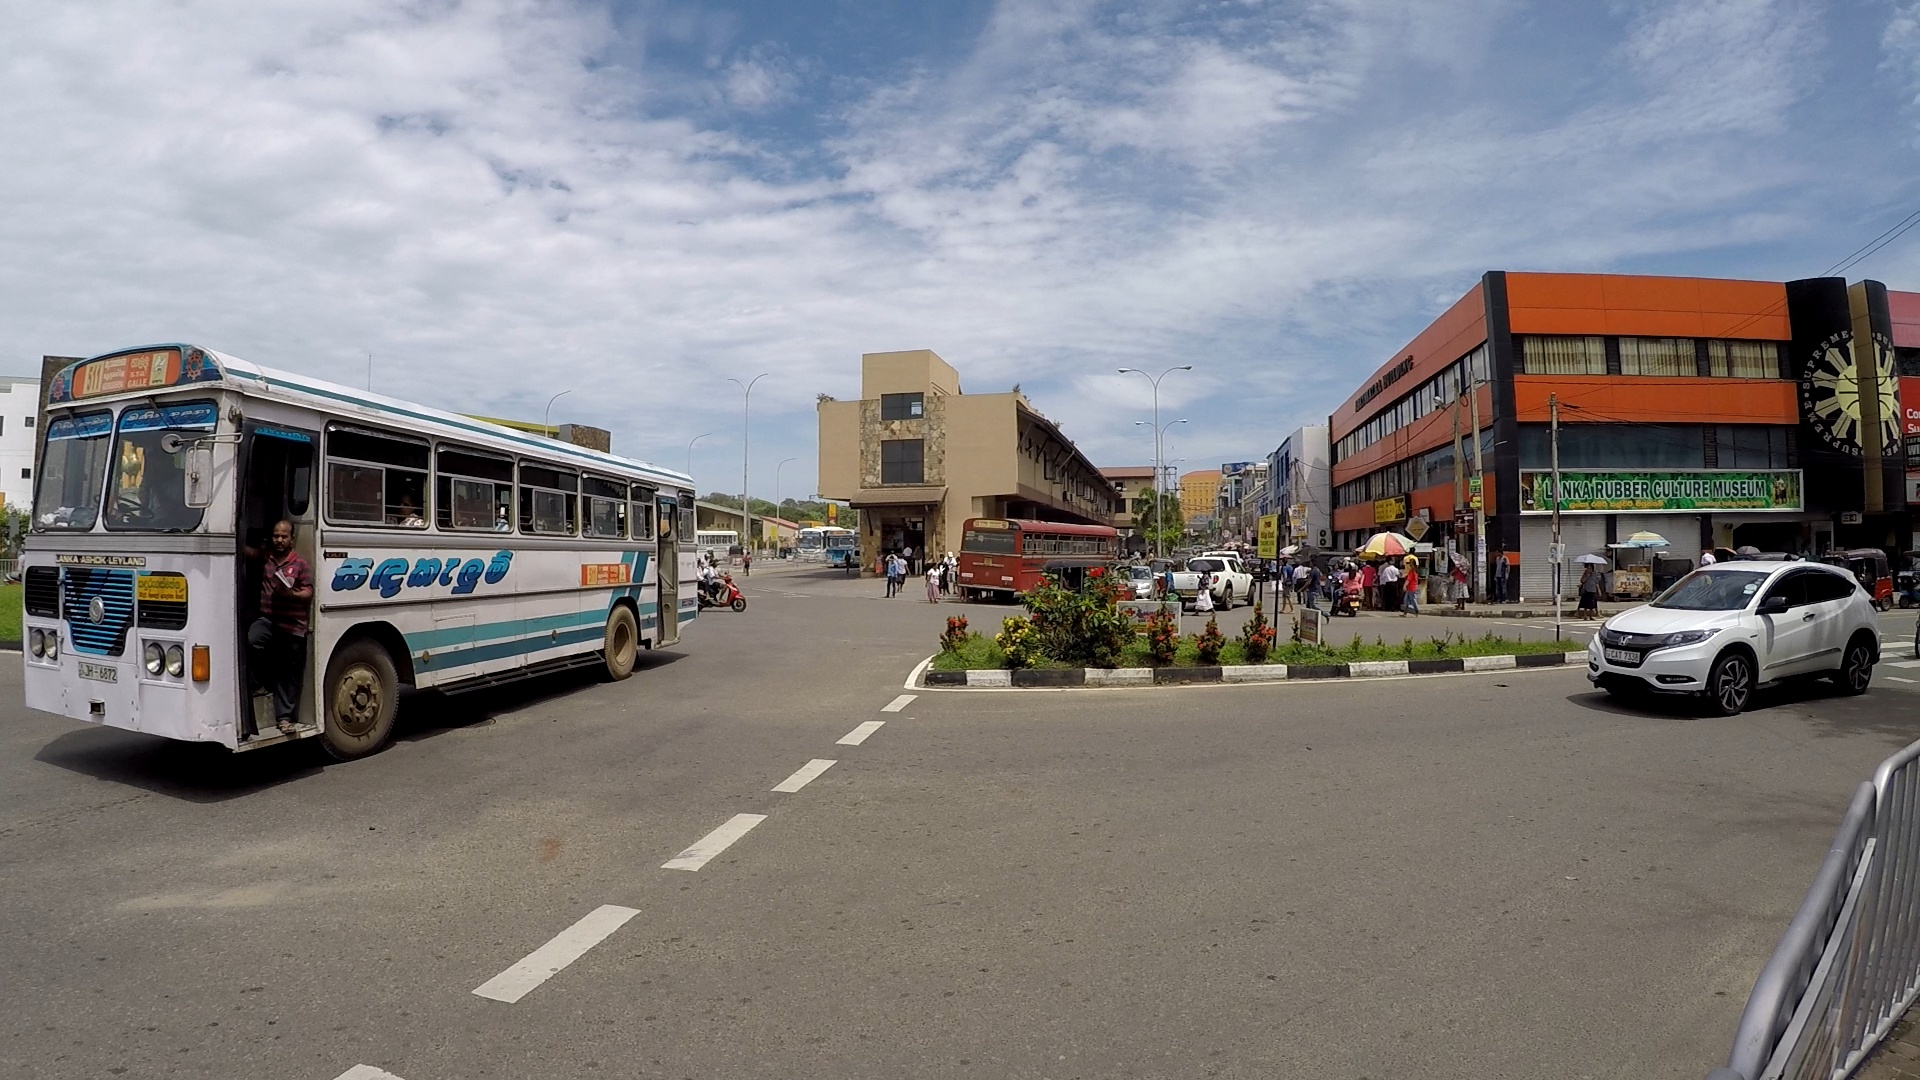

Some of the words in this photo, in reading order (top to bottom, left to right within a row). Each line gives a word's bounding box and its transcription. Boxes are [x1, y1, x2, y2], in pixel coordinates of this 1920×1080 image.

[1906, 408, 1920, 419] Co
[1595, 481, 1649, 499] RUBBER
[1652, 480, 1710, 498] CULTURE
[1712, 480, 1766, 498] MUSEUM
[56, 554, 79, 563] LANKA
[80, 555, 107, 565] ASHOK
[108, 556, 145, 566] LEYLAND
